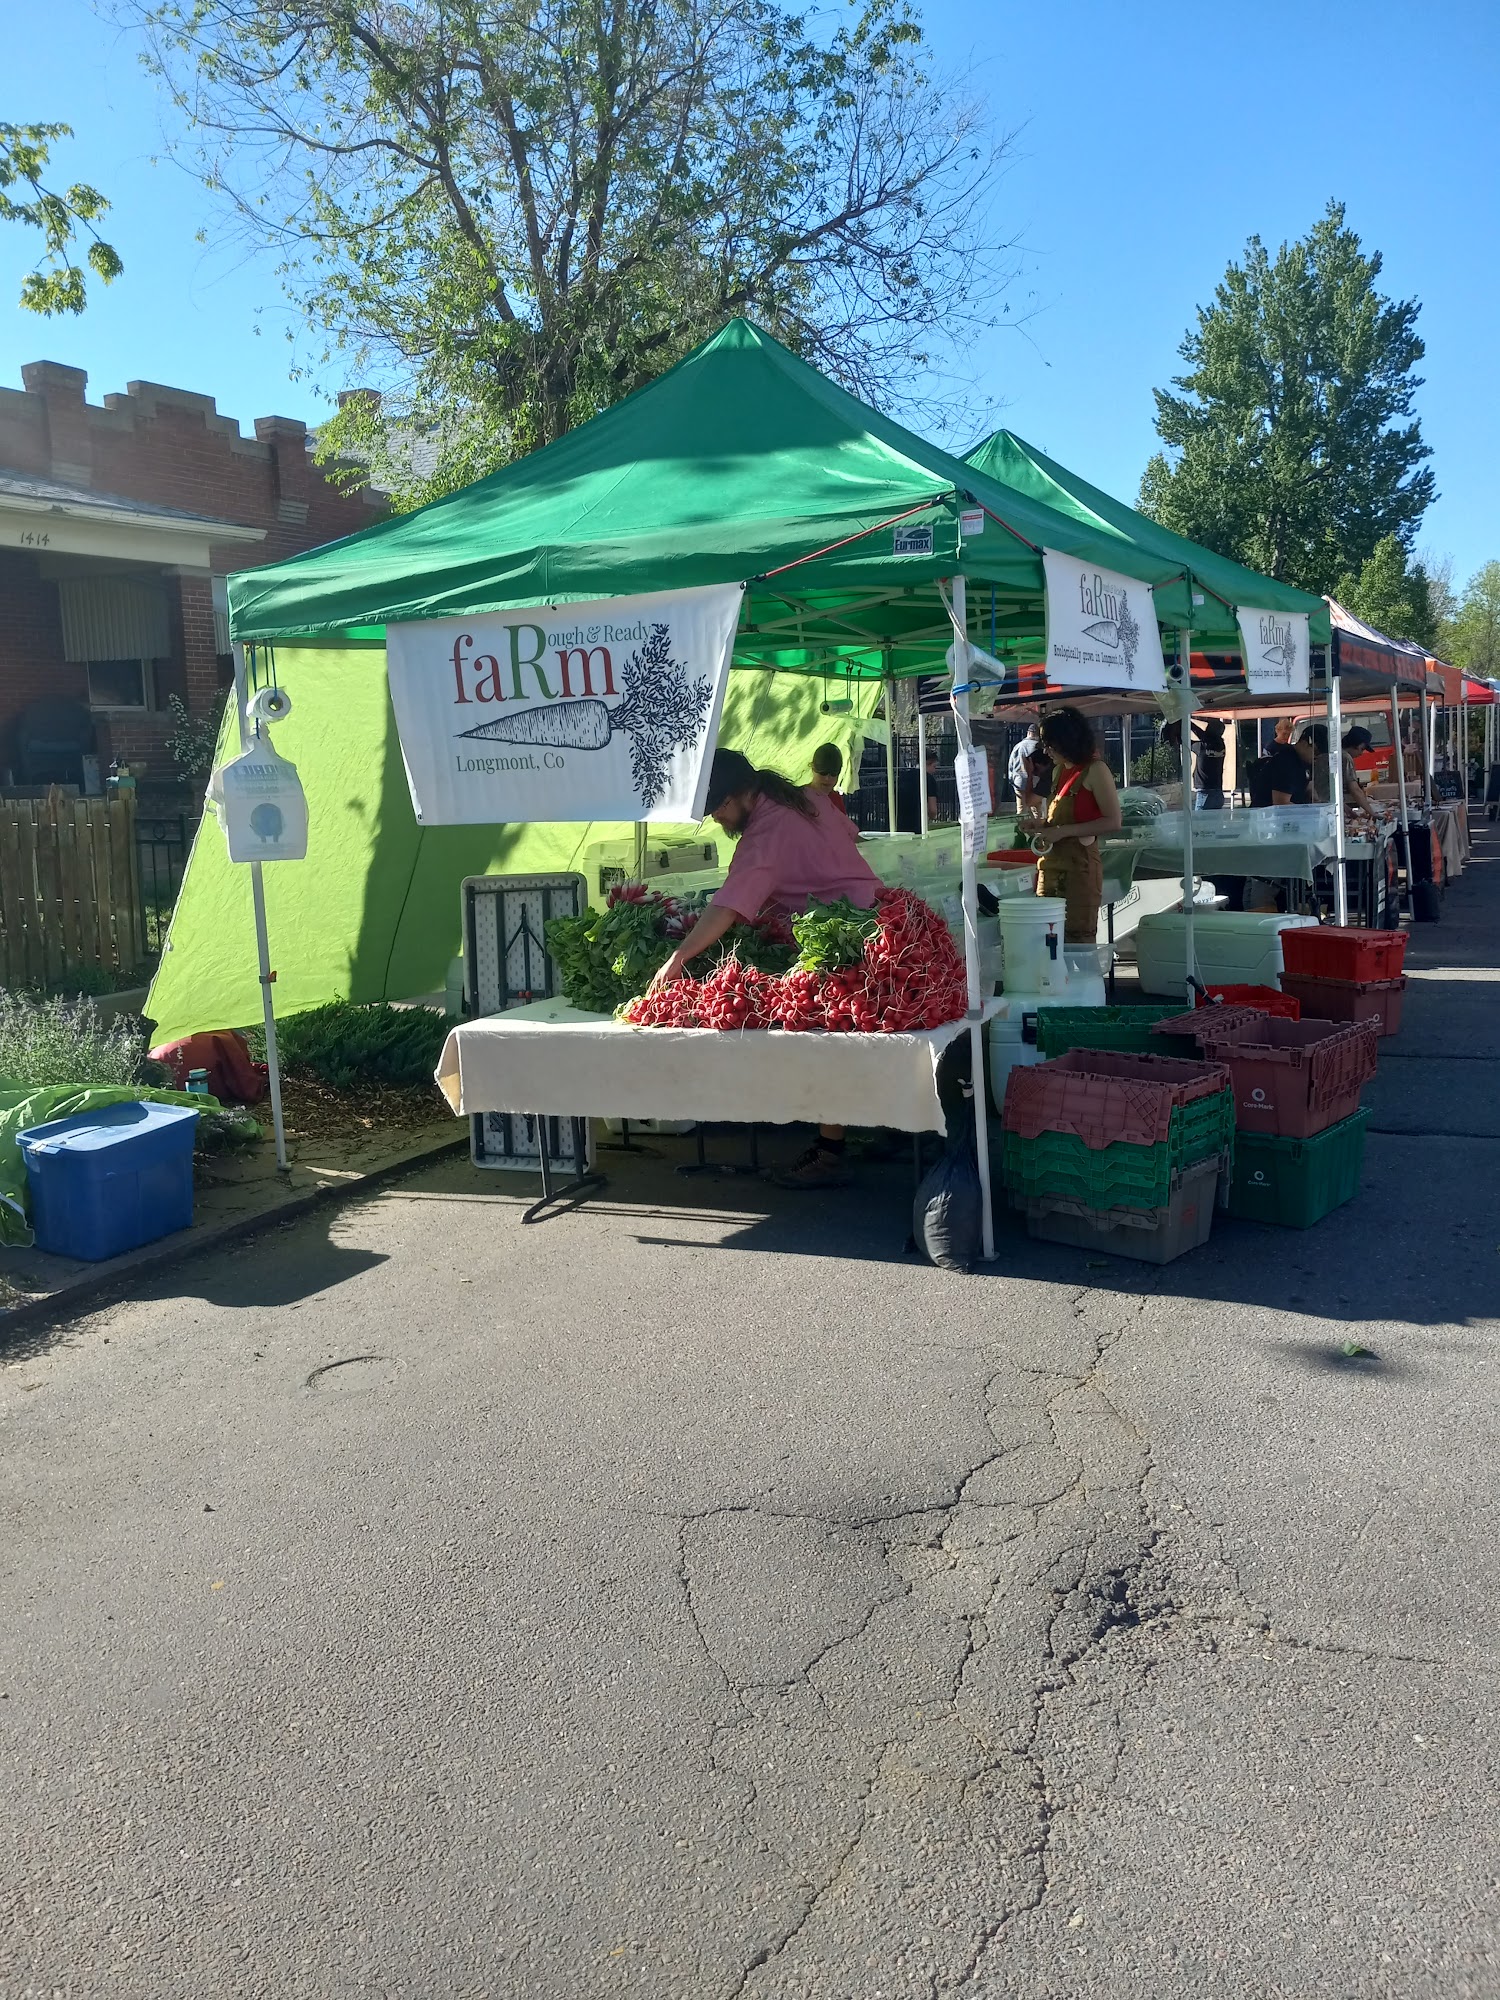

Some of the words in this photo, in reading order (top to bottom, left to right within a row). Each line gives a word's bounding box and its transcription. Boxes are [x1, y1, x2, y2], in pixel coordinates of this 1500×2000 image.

[21, 531, 50, 547] 1414
[895, 539, 930, 551] Eurmax
[1080, 573, 1119, 621] faRm
[603, 621, 651, 643] Ready
[449, 624, 620, 704] faRm
[456, 753, 540, 774] Longmont,
[543, 752, 565, 769] Co
